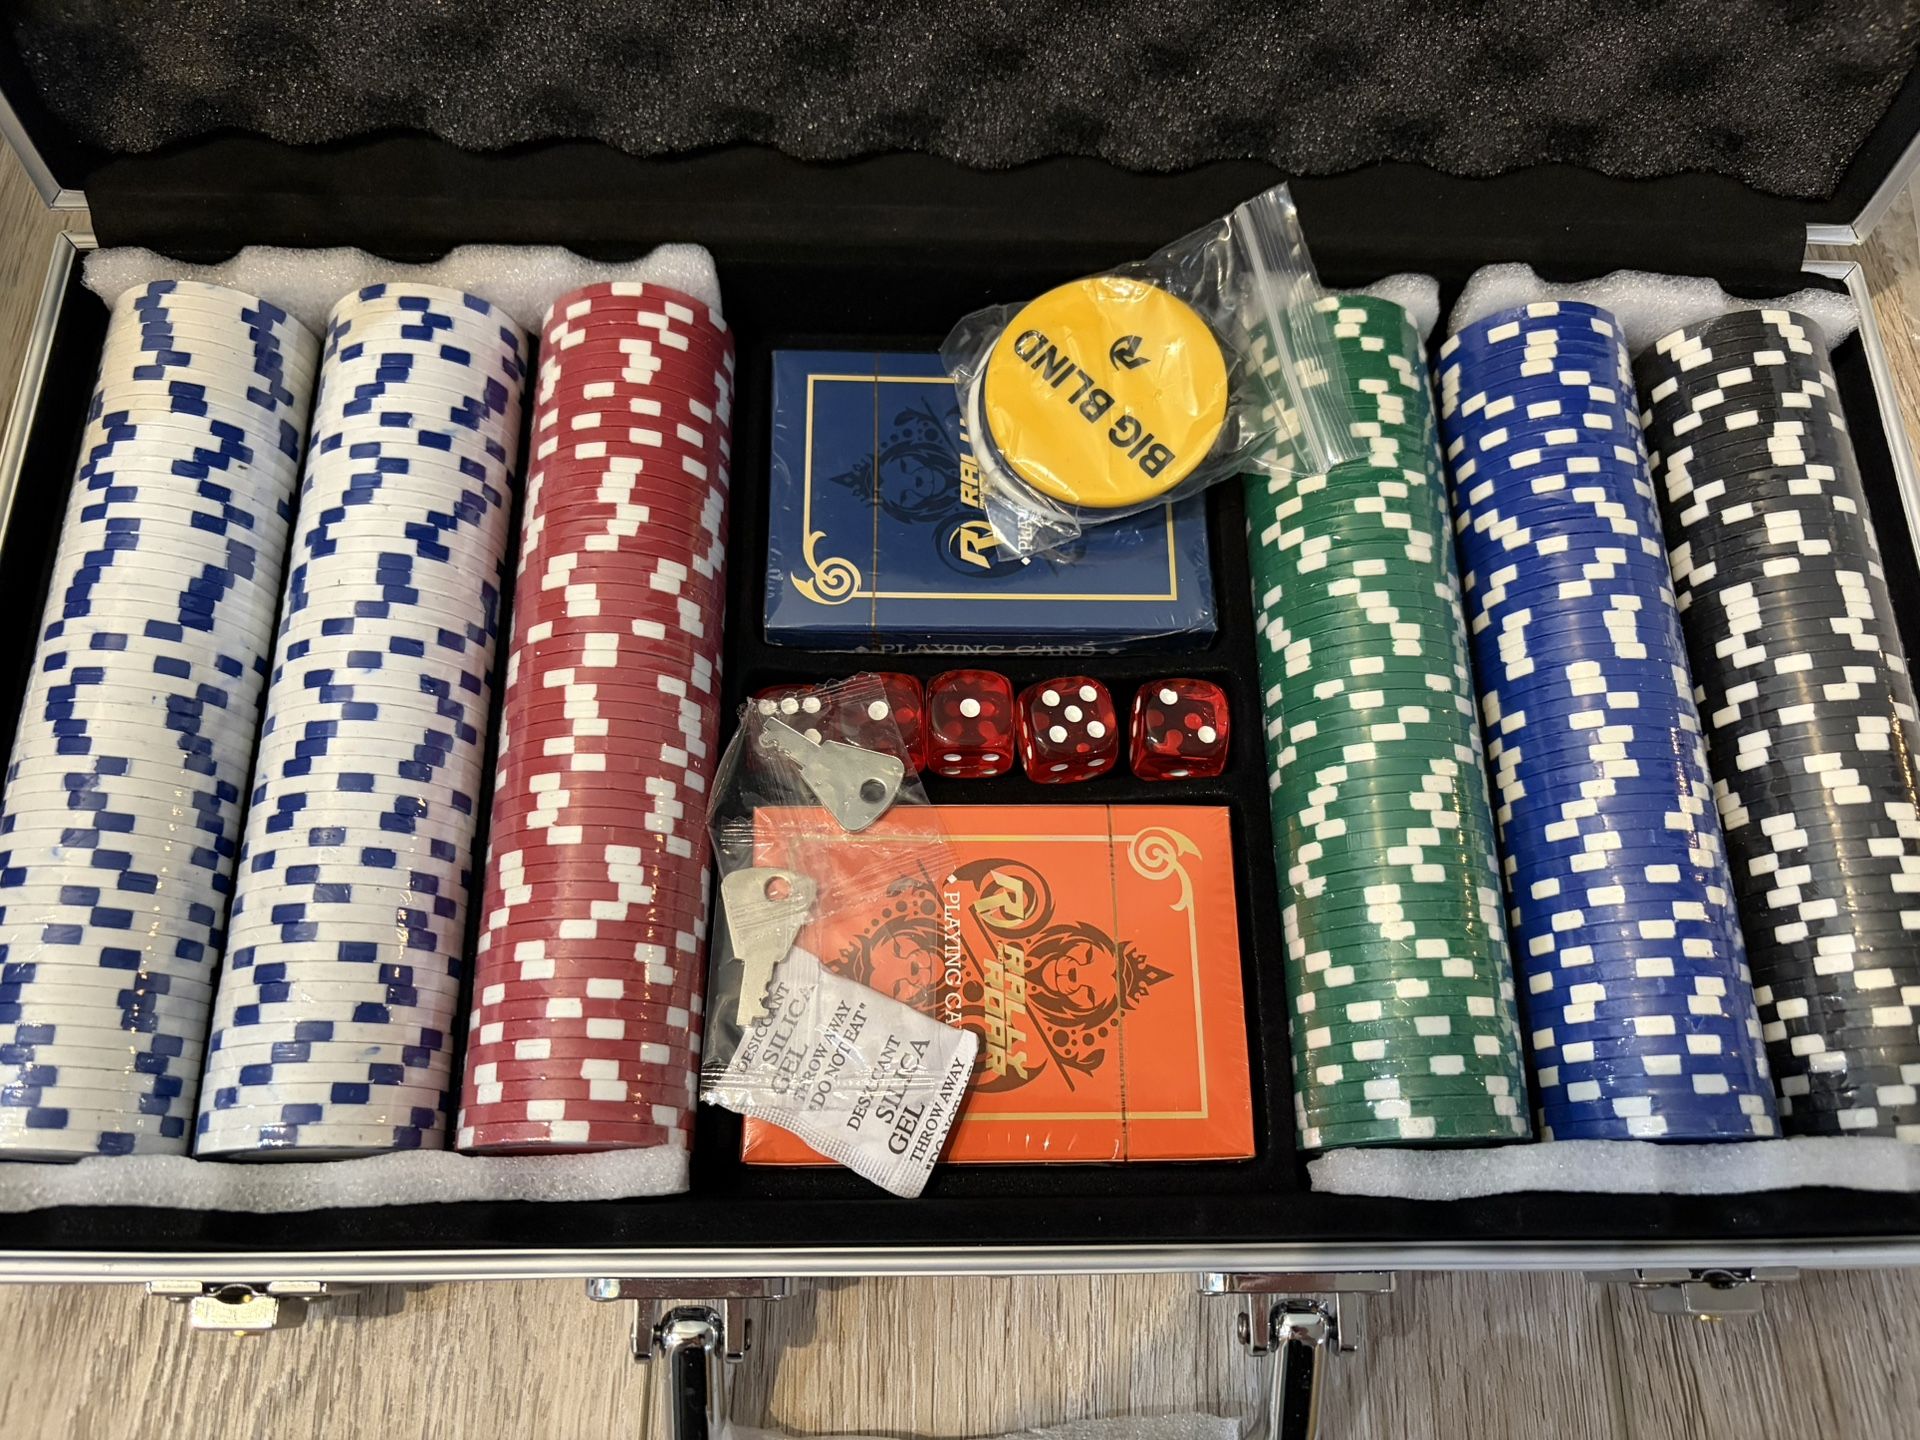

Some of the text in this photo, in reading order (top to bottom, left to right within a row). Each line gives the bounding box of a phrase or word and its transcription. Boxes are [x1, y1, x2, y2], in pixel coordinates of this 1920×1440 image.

[1014, 330, 1175, 478] BIG BLIND
[880, 644, 1096, 656] PLAYING CARD
[944, 891, 962, 1029] PLAYING CA
[737, 982, 790, 1073] DESICCANT
[762, 985, 816, 1065] SILICA
[794, 1000, 851, 1101] THROW AWAY
[824, 1042, 850, 1079] NOT
[843, 1002, 867, 1044] EAT"
[984, 958, 1006, 1076] ROAR
[1004, 943, 1028, 1080] RALLY
[772, 1044, 808, 1094] GEL
[876, 1040, 930, 1124] SILICA
[910, 1057, 965, 1162] THROW AWAY
[888, 1101, 926, 1155] GEL
